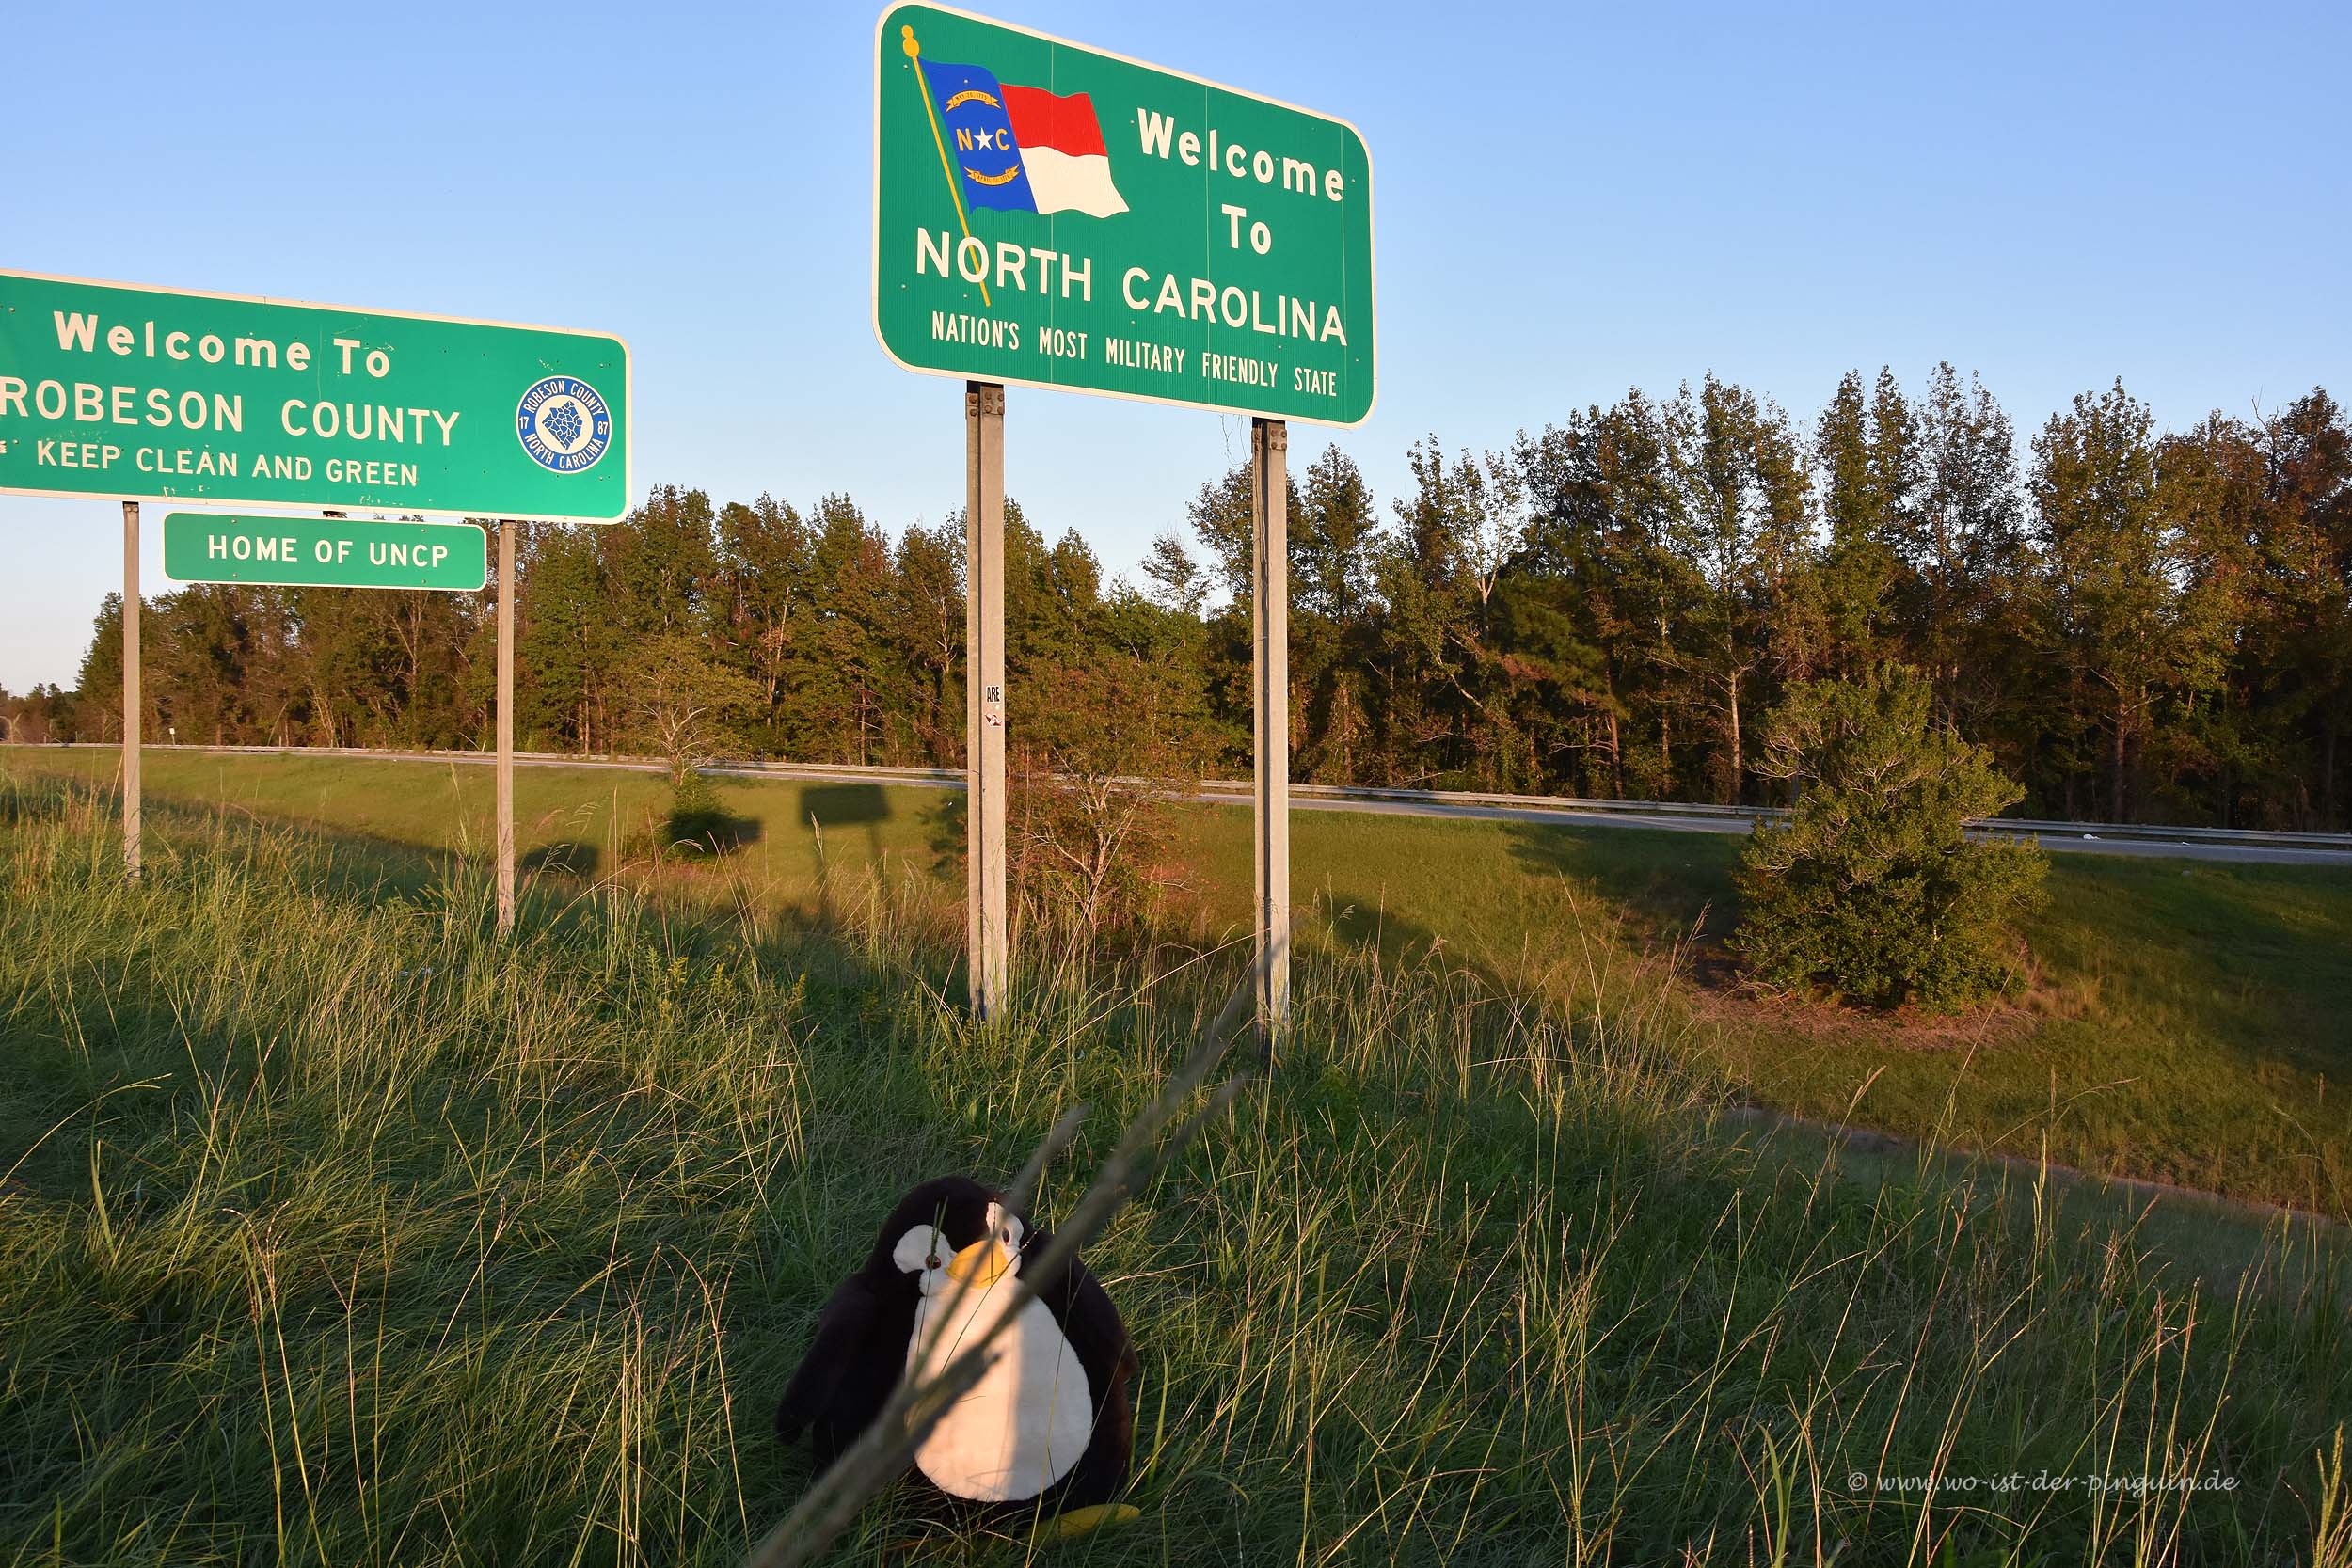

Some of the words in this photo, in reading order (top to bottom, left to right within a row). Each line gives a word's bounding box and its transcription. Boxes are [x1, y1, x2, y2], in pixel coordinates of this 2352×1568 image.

[1137, 107, 1344, 202] Welcome
[1222, 203, 1272, 255] To
[916, 227, 1091, 302] NORTH
[1122, 267, 1348, 347] CAROLINA
[54, 310, 310, 371] Welcome
[333, 338, 390, 378] To
[932, 310, 1020, 351] NATION'S
[1039, 326, 1088, 360] MOST
[1105, 337, 1185, 373] MILITARY
[1202, 352, 1279, 388] FRIENDLY
[1294, 367, 1337, 397] STATE
[0, 375, 243, 432] ROBESON
[281, 399, 460, 446] COUNTY
[523, 380, 564, 414] ROBESON
[570, 383, 605, 416] COUNTY
[519, 416, 530, 430] 17
[597, 420, 609, 436] 87
[37, 440, 121, 469] KEEP
[136, 447, 237, 477] CLEAN
[252, 454, 312, 481] AND
[326, 458, 418, 487] GREEN
[525, 433, 555, 465] NORTH
[559, 437, 605, 469] CAROLINA
[208, 534, 298, 562] HOME
[314, 539, 353, 564] OF
[369, 542, 449, 568] UNCP
[987, 686, 999, 702] ARE
